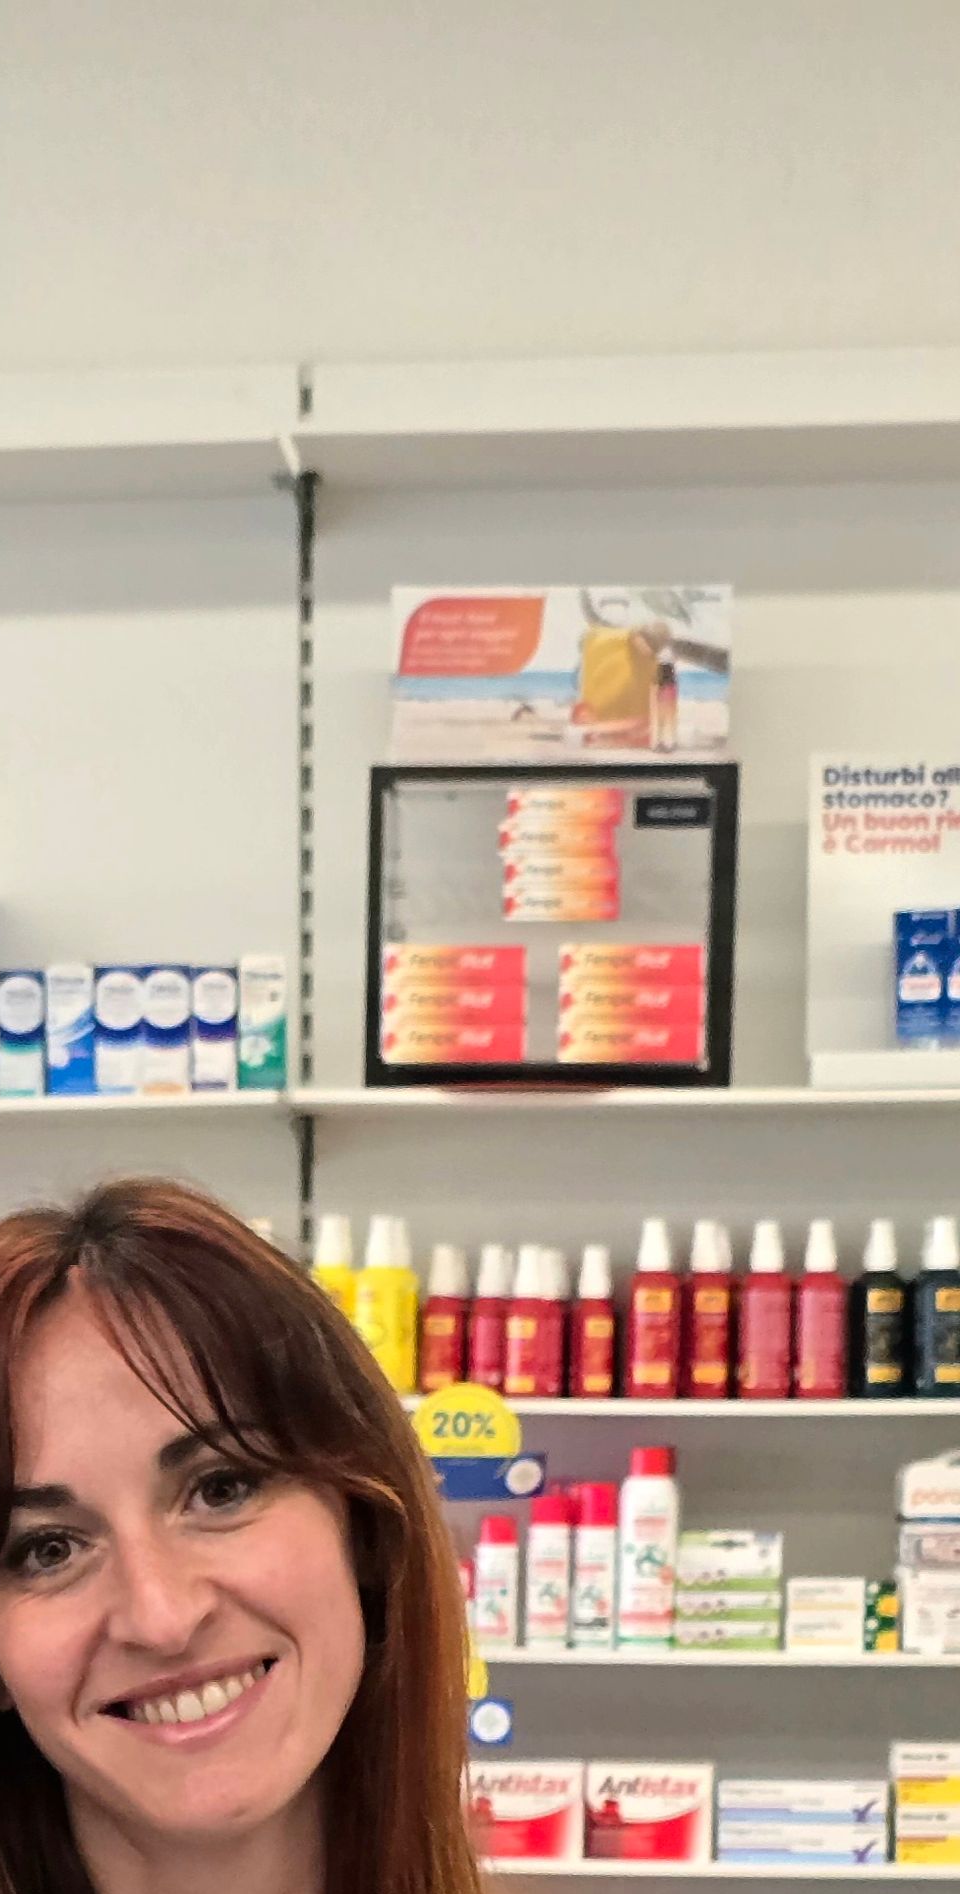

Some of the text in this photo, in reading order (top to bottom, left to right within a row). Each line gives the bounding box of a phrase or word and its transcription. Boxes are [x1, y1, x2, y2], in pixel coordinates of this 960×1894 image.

[824, 765, 925, 785] Disturbi
[824, 790, 948, 808] stomaco?
[864, 812, 930, 831] buon
[432, 1411, 497, 1438] 20%
